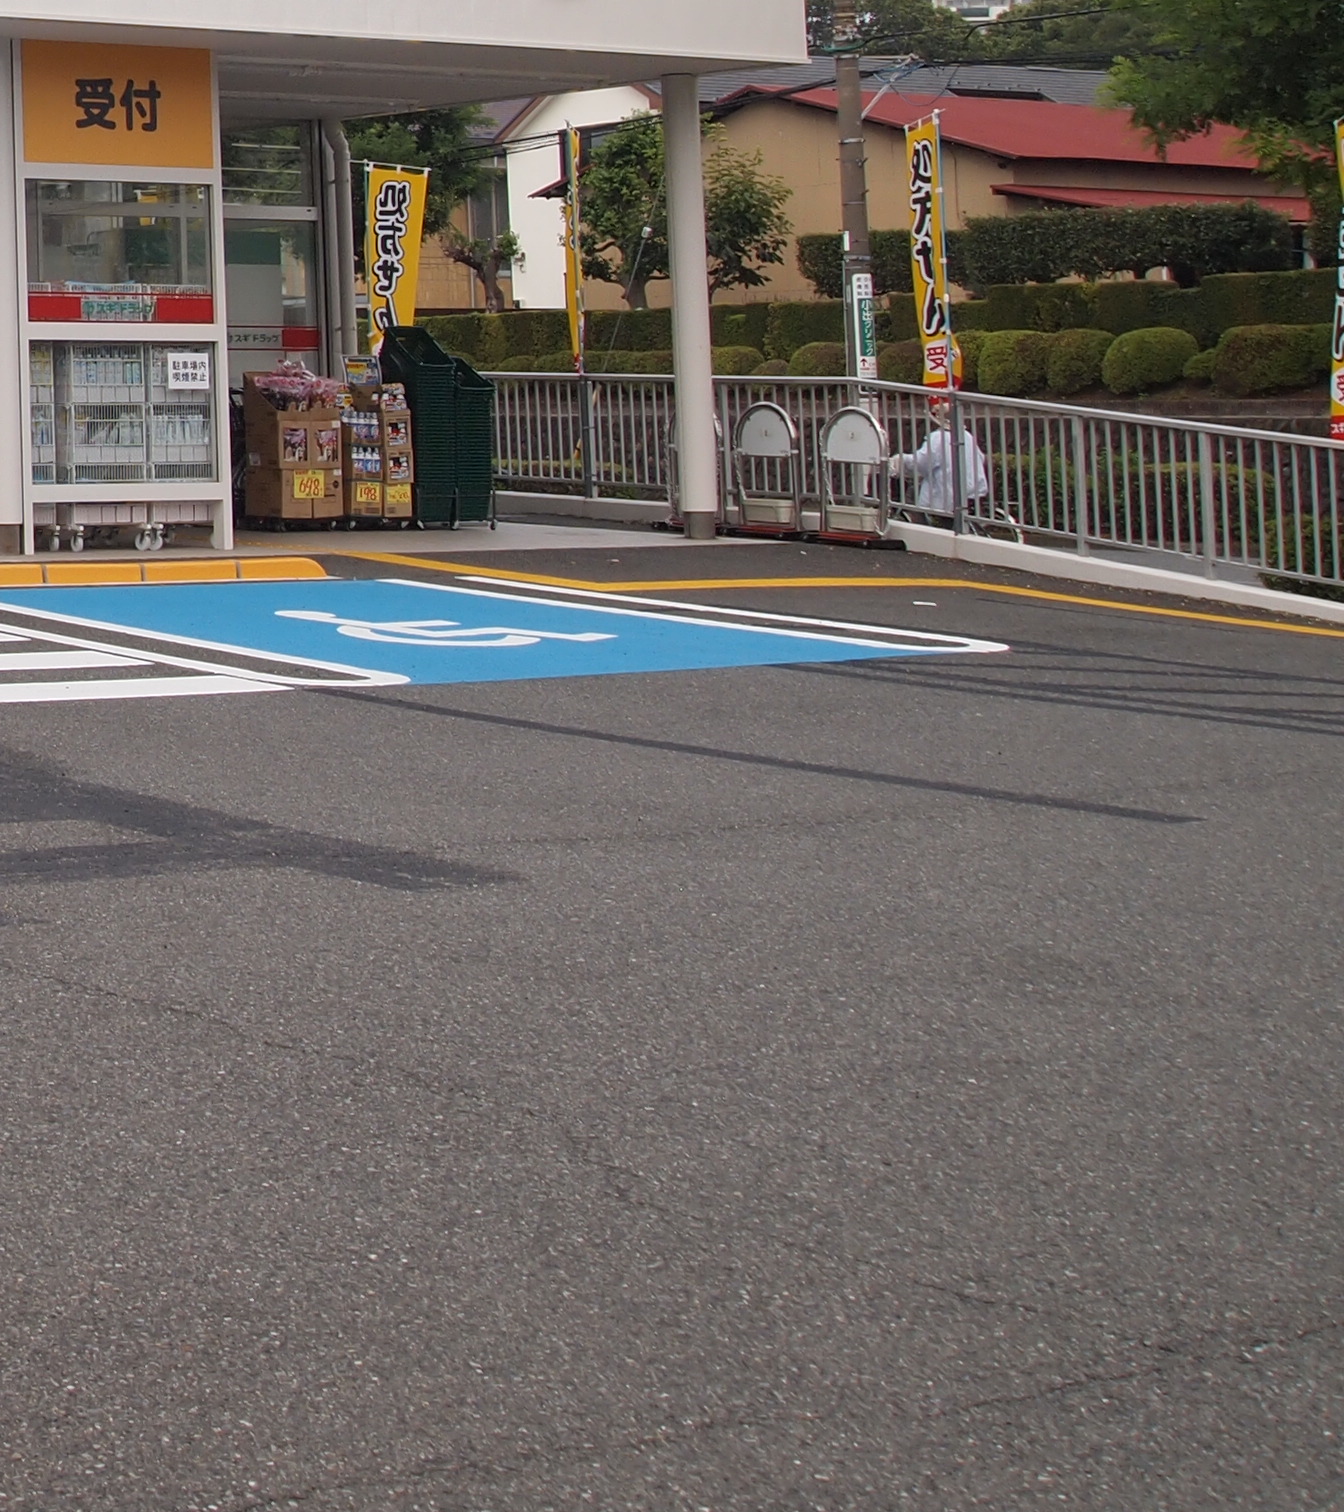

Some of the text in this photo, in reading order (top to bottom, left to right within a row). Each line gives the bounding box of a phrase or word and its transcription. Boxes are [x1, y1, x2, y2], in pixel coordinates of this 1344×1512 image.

[74, 78, 162, 133] 受付
[172, 360, 207, 371] 駐車場内
[172, 371, 207, 382] 喫煙禁止
